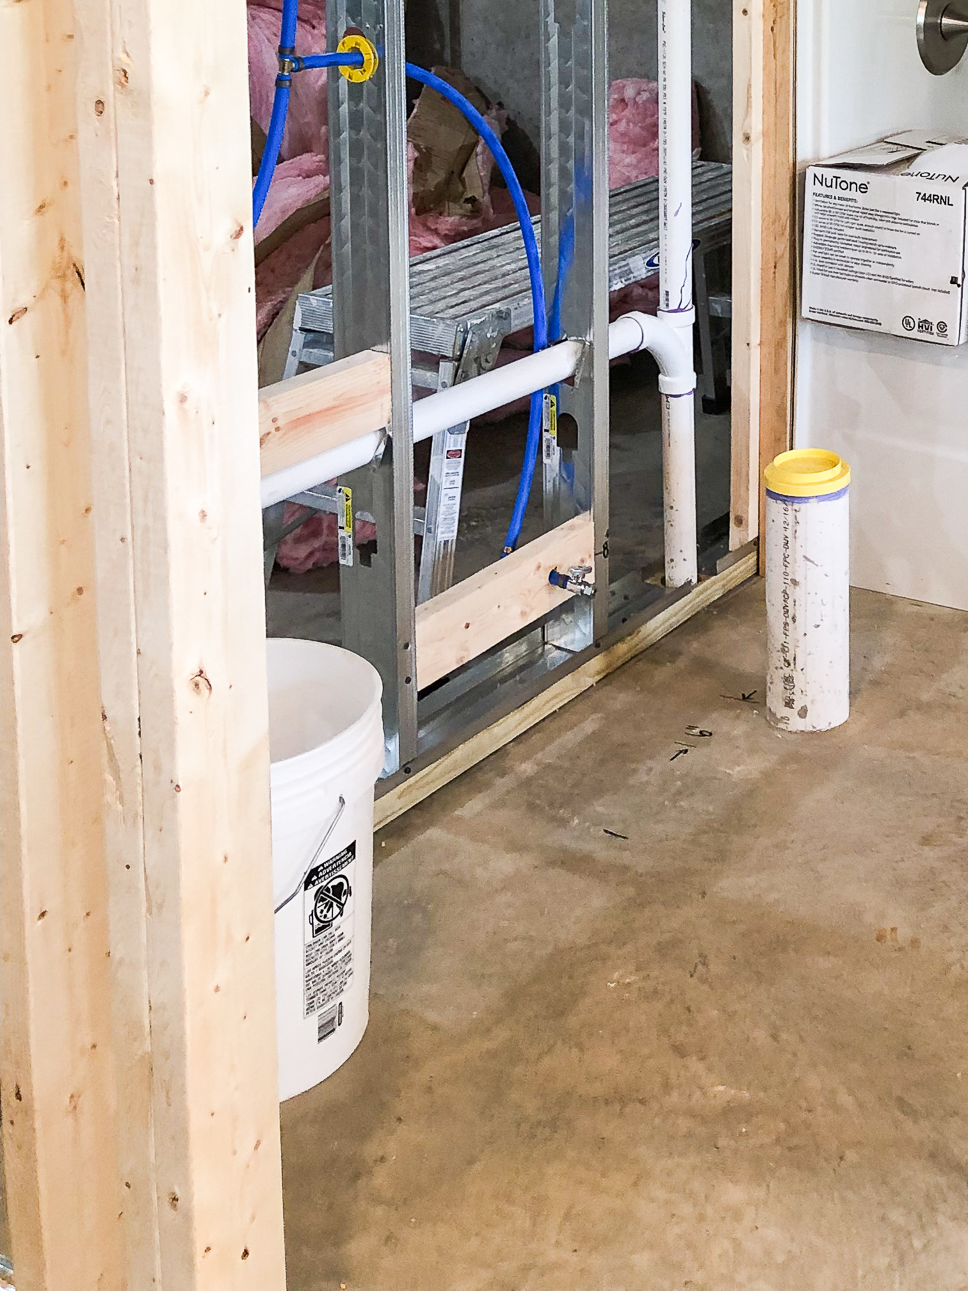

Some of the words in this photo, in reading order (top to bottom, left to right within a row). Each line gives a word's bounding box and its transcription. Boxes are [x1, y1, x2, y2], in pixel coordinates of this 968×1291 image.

[812, 173, 869, 194] NuTone
[900, 171, 960, 184] NuTone
[915, 191, 954, 207] 744RNL
